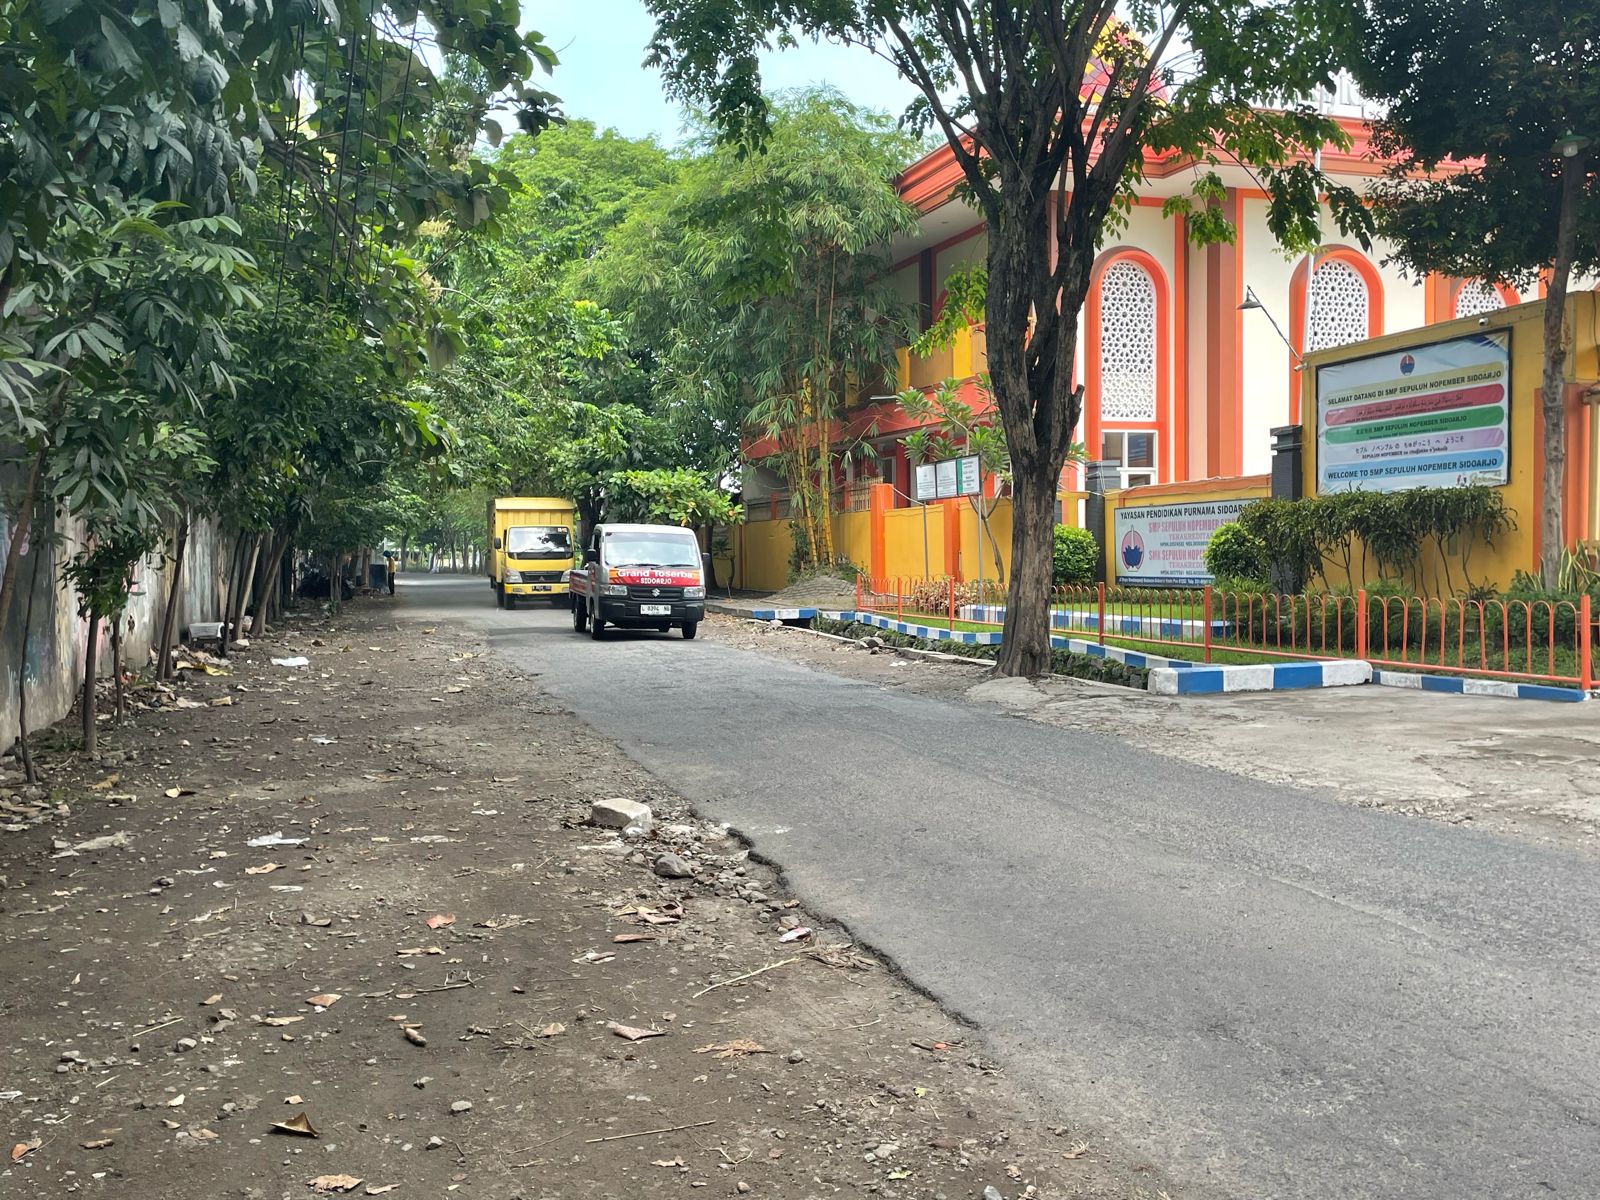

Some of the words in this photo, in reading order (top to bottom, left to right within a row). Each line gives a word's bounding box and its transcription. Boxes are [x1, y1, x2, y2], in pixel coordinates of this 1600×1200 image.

[1328, 394, 1353, 405] SELAMAT
[1353, 391, 1376, 401] DATANG
[1377, 389, 1384, 397] DI
[1385, 387, 1398, 396] SMP
[1399, 382, 1428, 394] SEPULUH
[1429, 376, 1466, 389] NOPEMBER
[1467, 370, 1502, 382] SIDOARJO
[1385, 421, 1408, 432] SEPULUH
[1409, 418, 1438, 429] NOPEMBER
[1439, 415, 1467, 424] SIDOARJO
[1328, 469, 1359, 479] WELCOME
[1360, 469, 1368, 477] TO
[1369, 467, 1383, 476] SMP
[1385, 465, 1416, 475] SEPULUH
[1417, 461, 1457, 472] NOPEMBER
[1459, 458, 1498, 468] SIDOARJO
[1120, 510, 1145, 520] YAYASAN
[1146, 508, 1182, 519] PENDIDIKAN
[1184, 505, 1216, 517] PURNAMA
[1161, 520, 1186, 533] SEPULUH
[1162, 549, 1186, 561] SEPULUH
[618, 569, 650, 577] Grand
[640, 577, 672, 585] SIDOARJO
